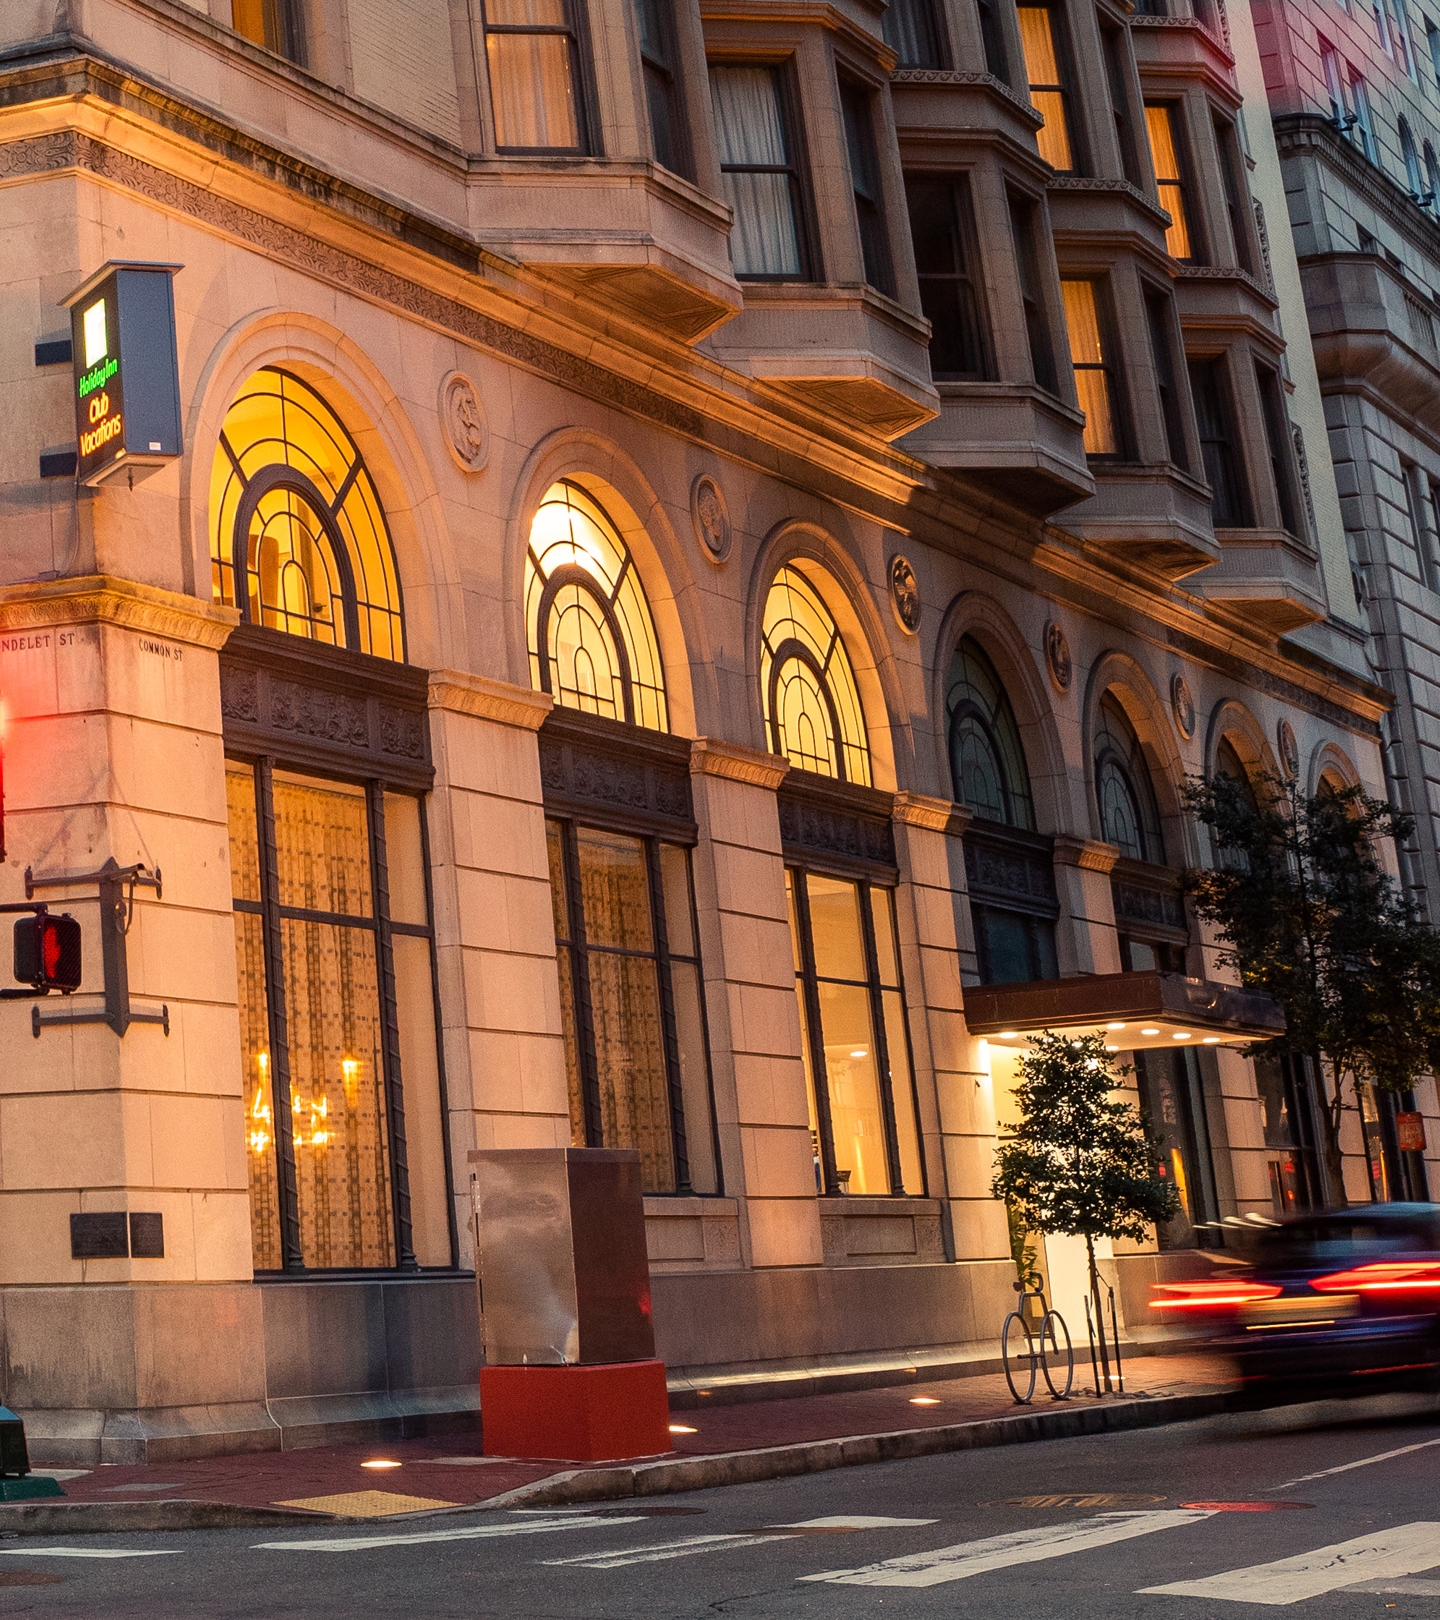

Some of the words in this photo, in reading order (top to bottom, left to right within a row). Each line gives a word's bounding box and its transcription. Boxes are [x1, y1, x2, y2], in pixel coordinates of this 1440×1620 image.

[79, 367, 106, 398] Holiday
[105, 358, 118, 379] Inn
[89, 391, 109, 423] Club
[80, 413, 121, 457] Vacations
[59, 633, 75, 646] ST
[138, 638, 171, 659] COMMON
[173, 648, 184, 662] ST
